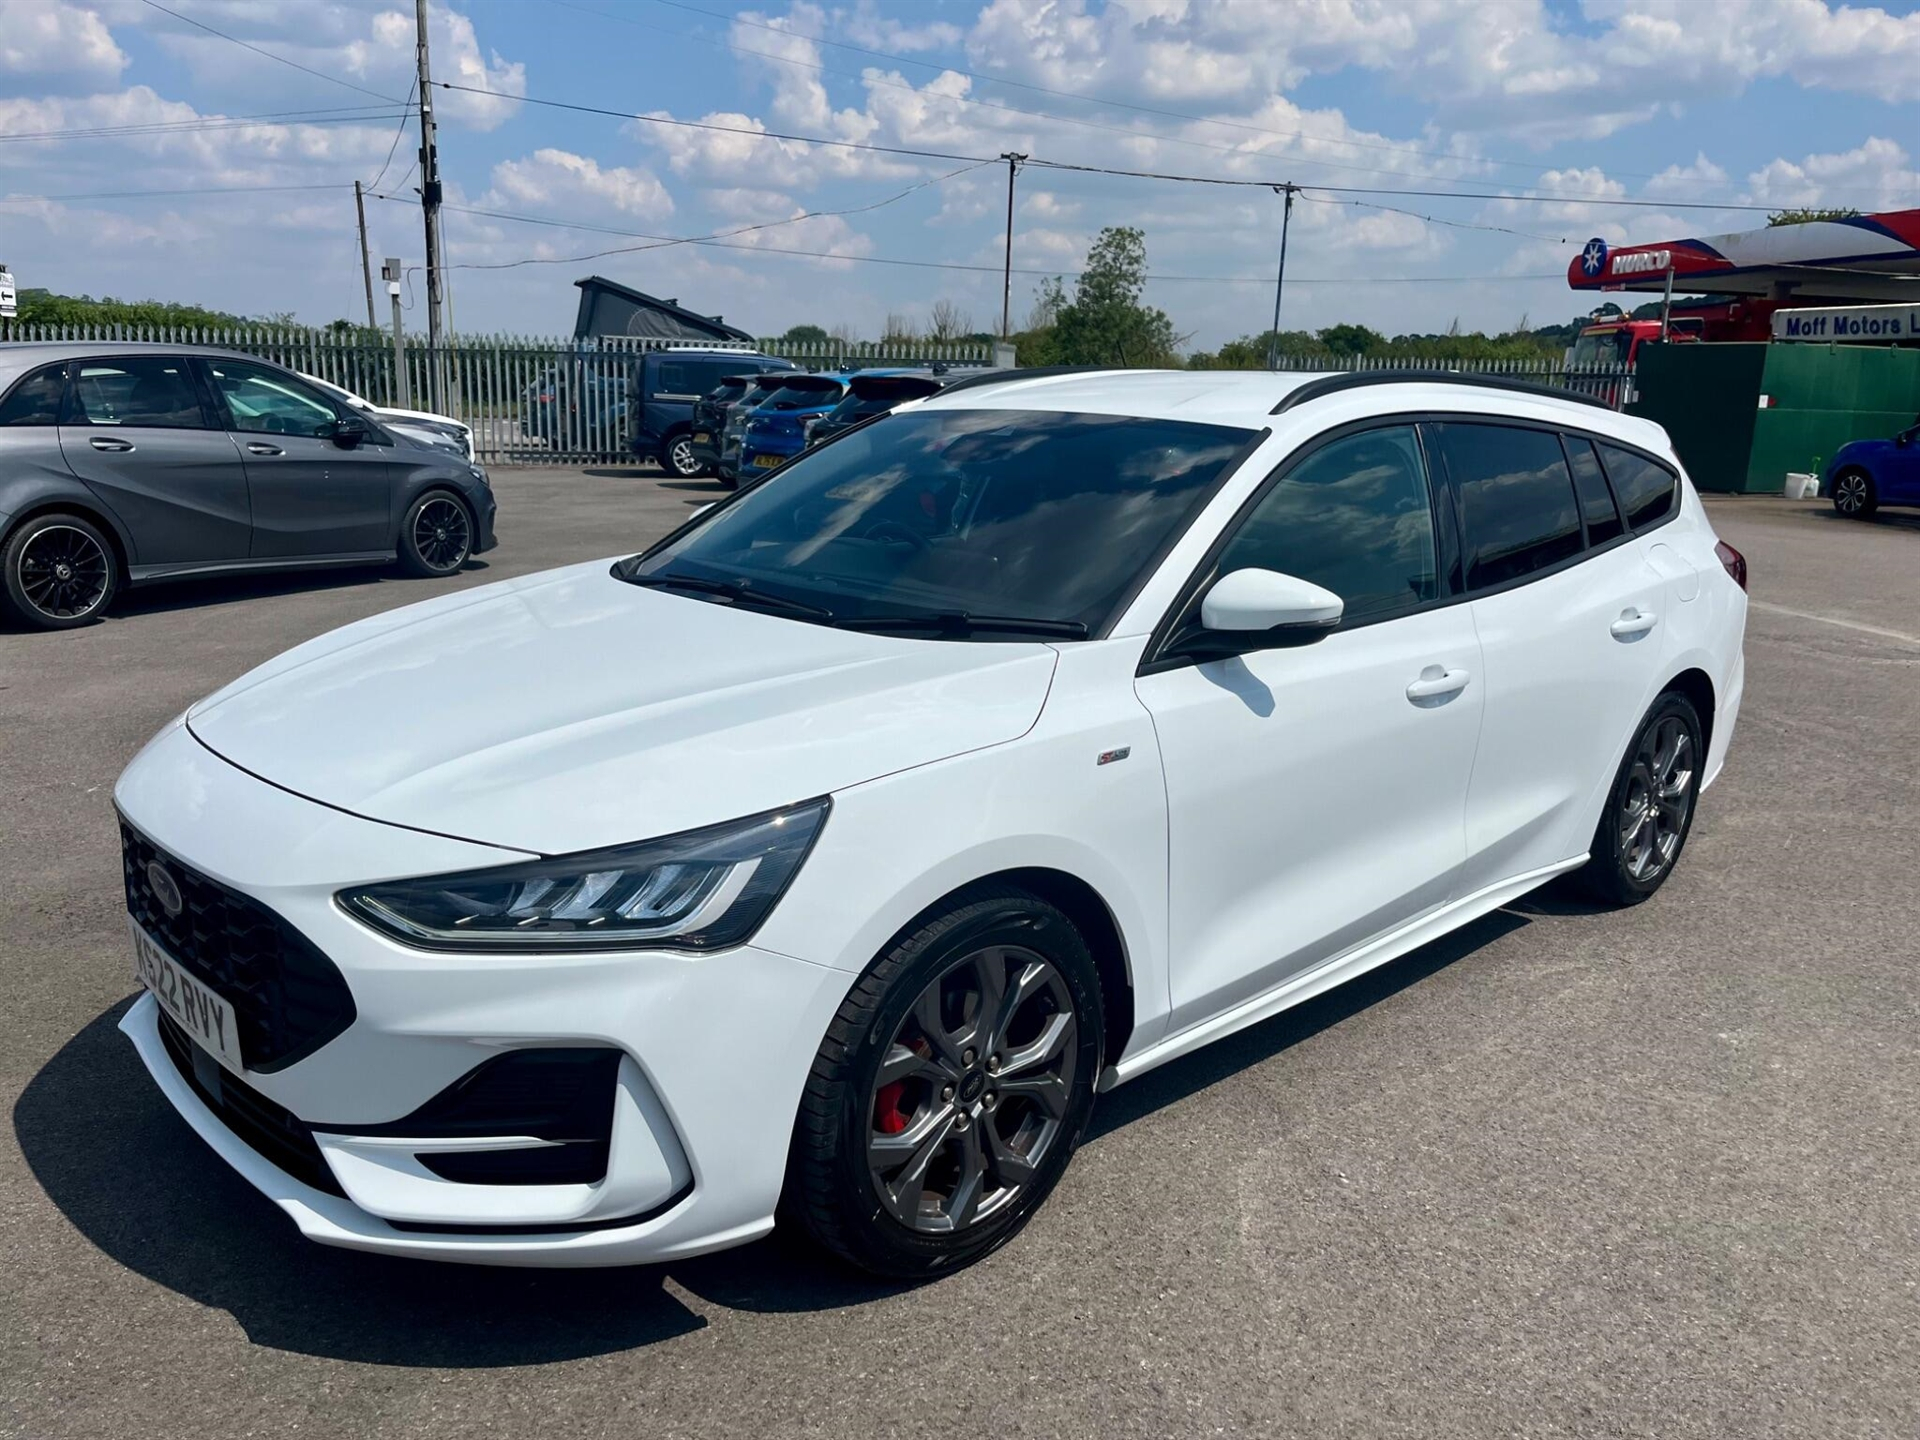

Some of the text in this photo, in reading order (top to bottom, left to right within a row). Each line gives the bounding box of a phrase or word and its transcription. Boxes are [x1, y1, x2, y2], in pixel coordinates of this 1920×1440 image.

[1611, 249, 1672, 275] MURCO
[1786, 316, 1827, 336] Moff
[1833, 315, 1901, 335] Motors
[180, 973, 226, 1052] RVY
